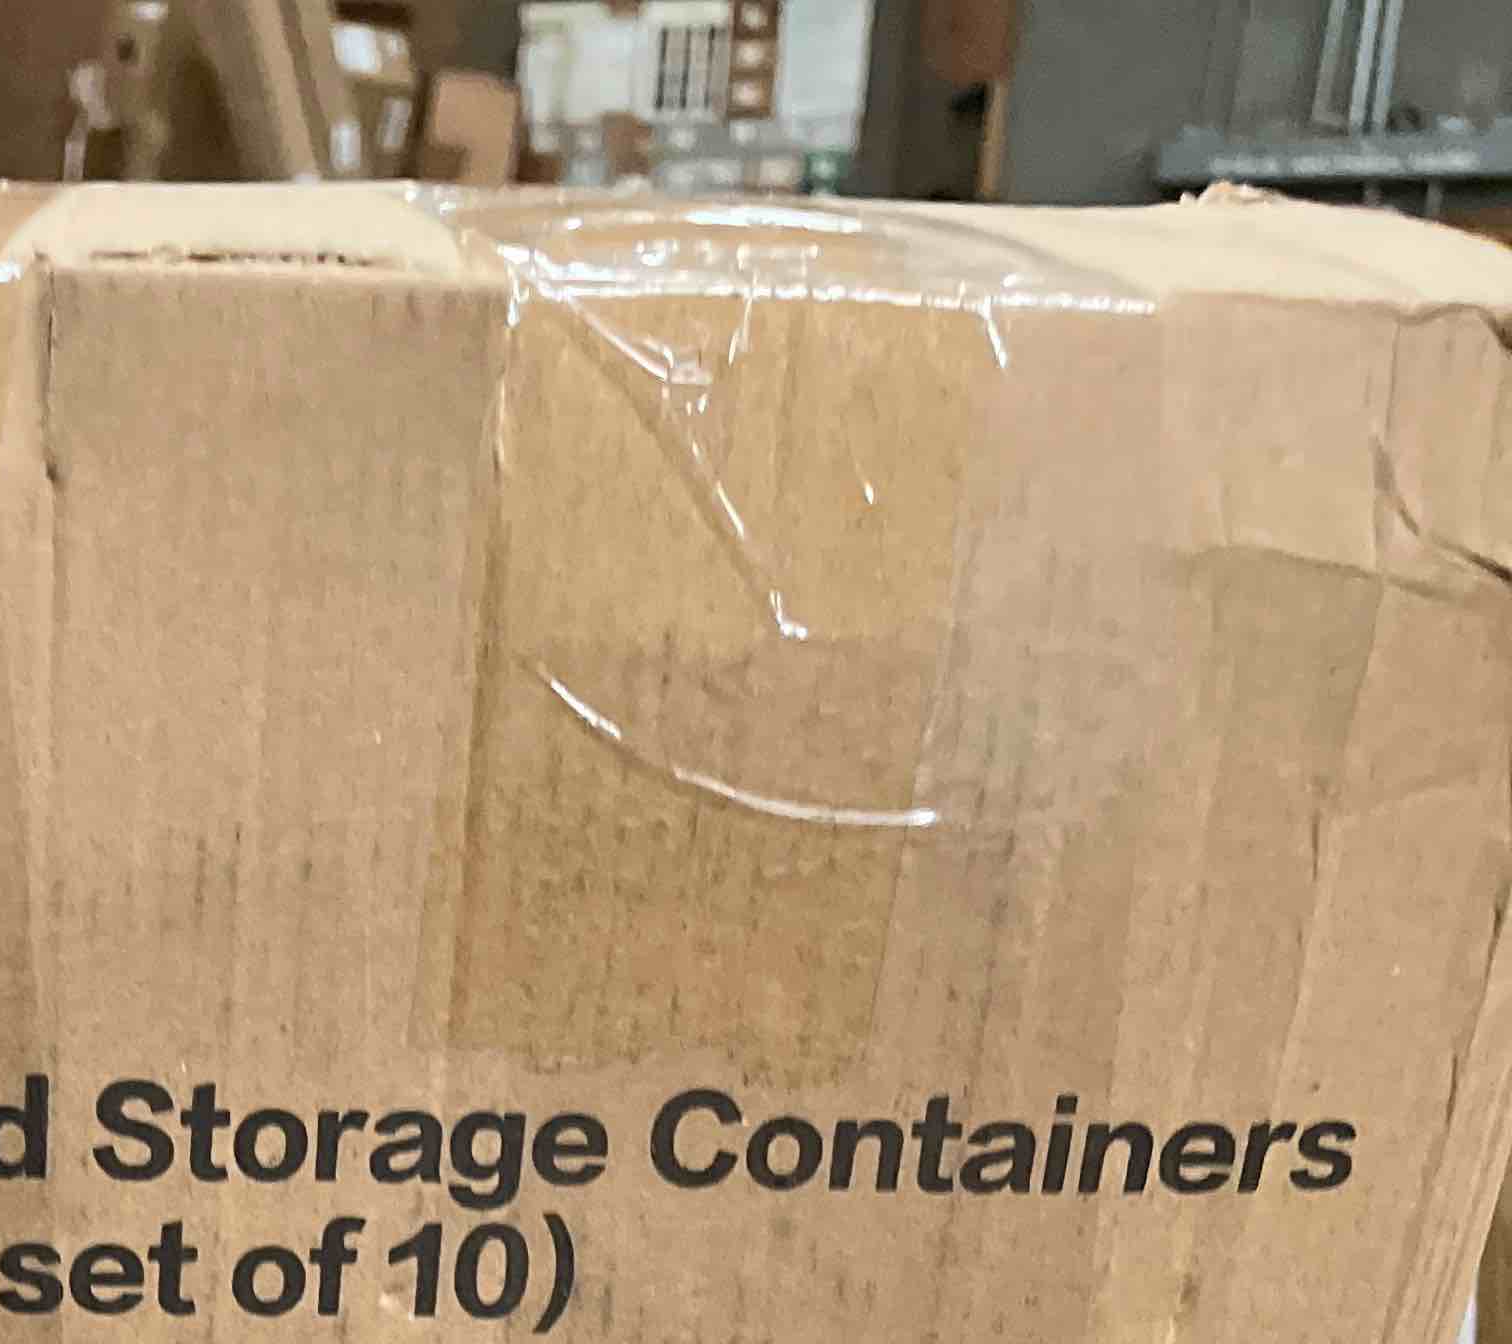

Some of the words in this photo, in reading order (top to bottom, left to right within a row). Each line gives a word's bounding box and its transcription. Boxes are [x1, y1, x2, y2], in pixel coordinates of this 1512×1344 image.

[92, 1079, 609, 1211] Storage
[649, 1088, 1357, 1195] Containers
[231, 1216, 366, 1317] of
[388, 1212, 576, 1333] 10)
